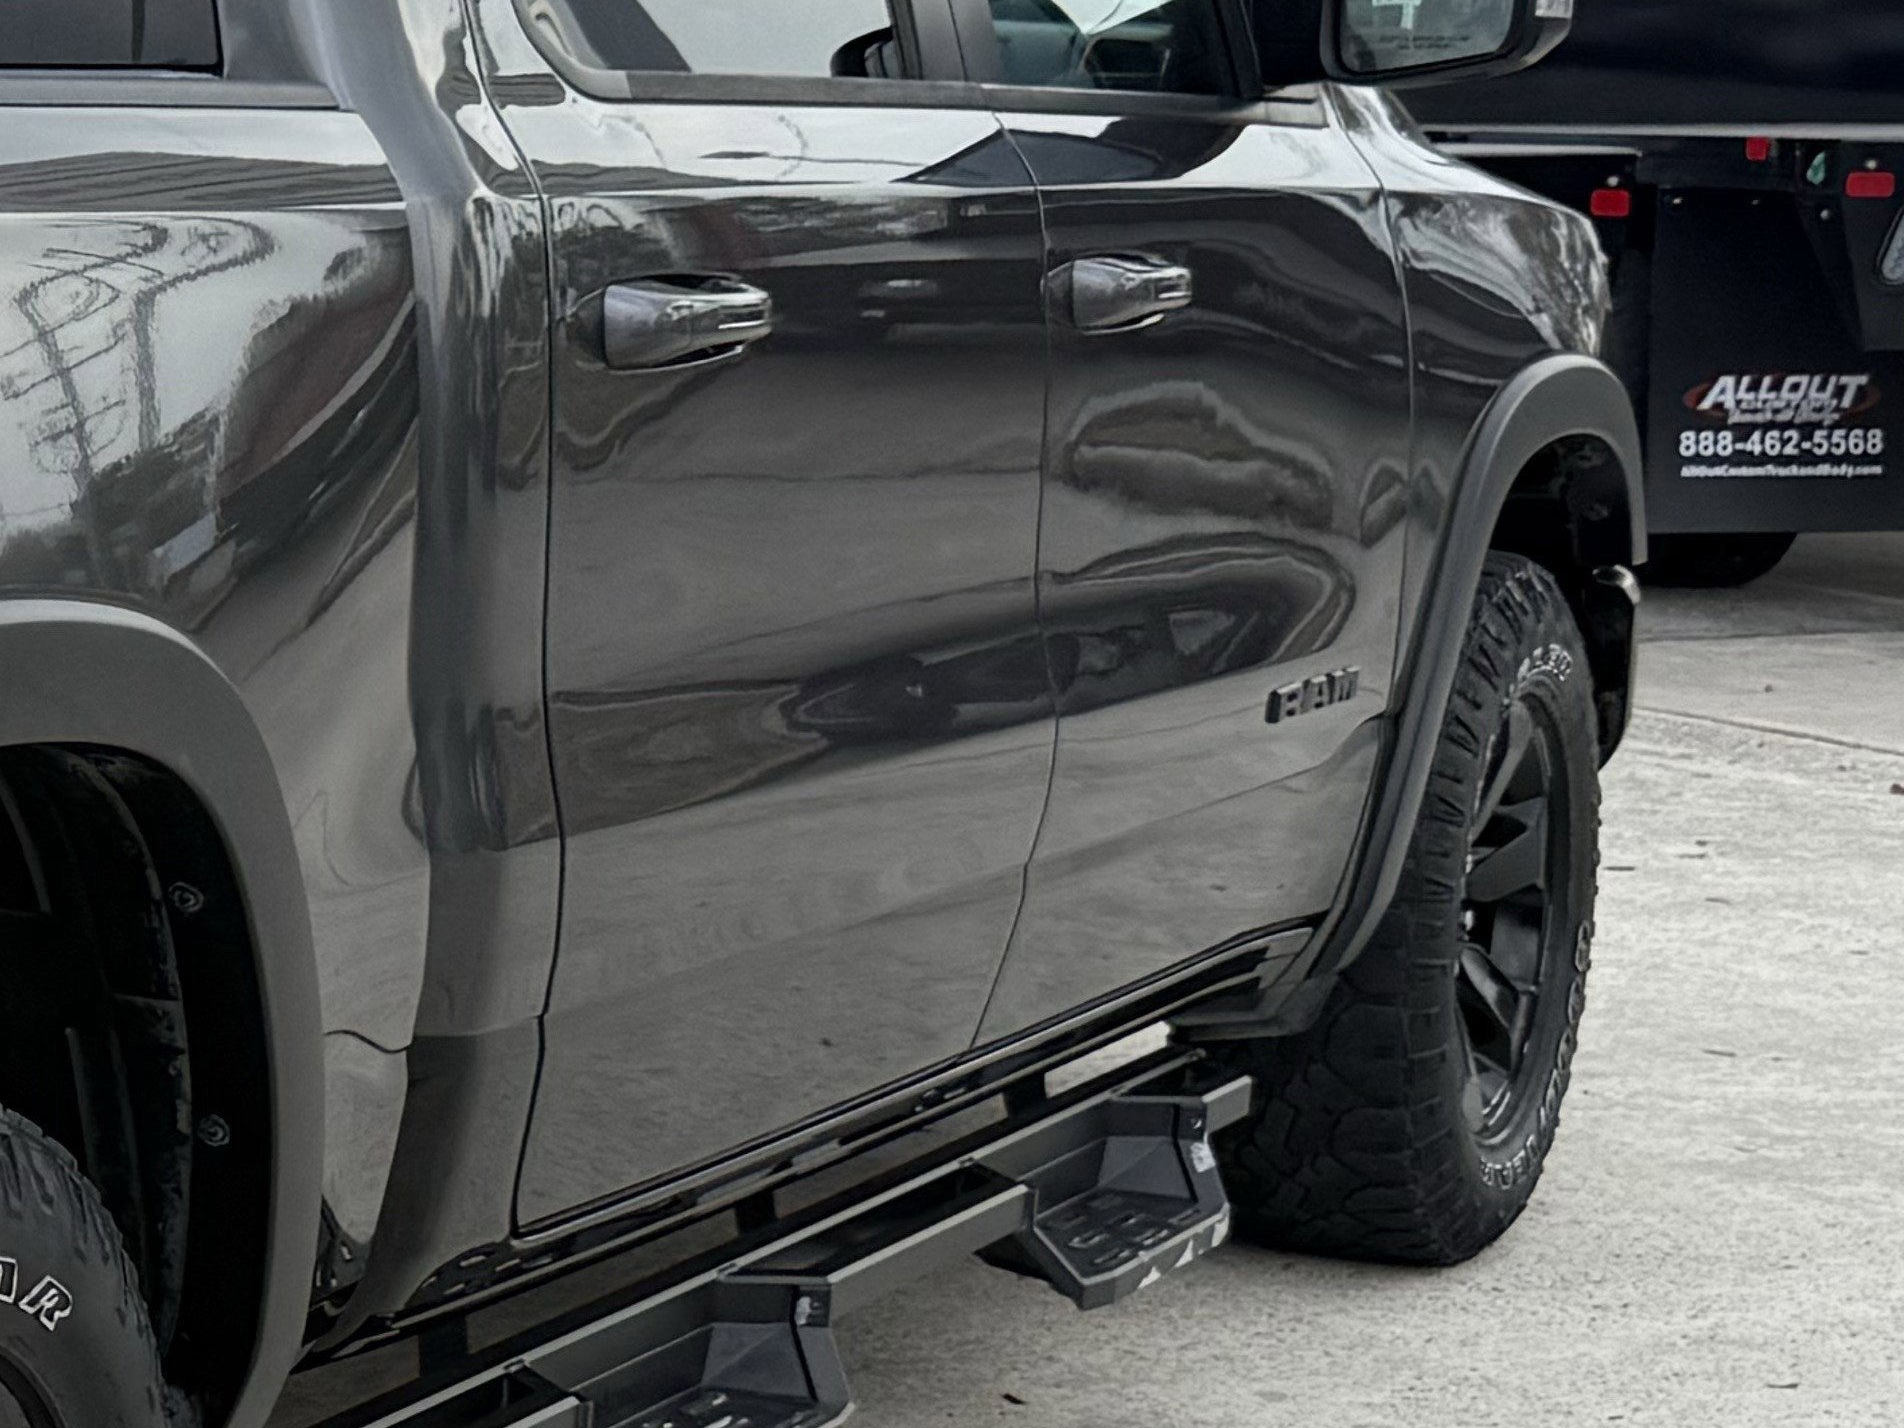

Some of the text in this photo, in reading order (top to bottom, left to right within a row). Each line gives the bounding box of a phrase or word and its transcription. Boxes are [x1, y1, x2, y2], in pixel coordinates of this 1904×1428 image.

[1696, 374, 1870, 411] ALLOUT
[1679, 428, 1884, 457] 888-462-5568
[1265, 666, 1360, 724] RAM
